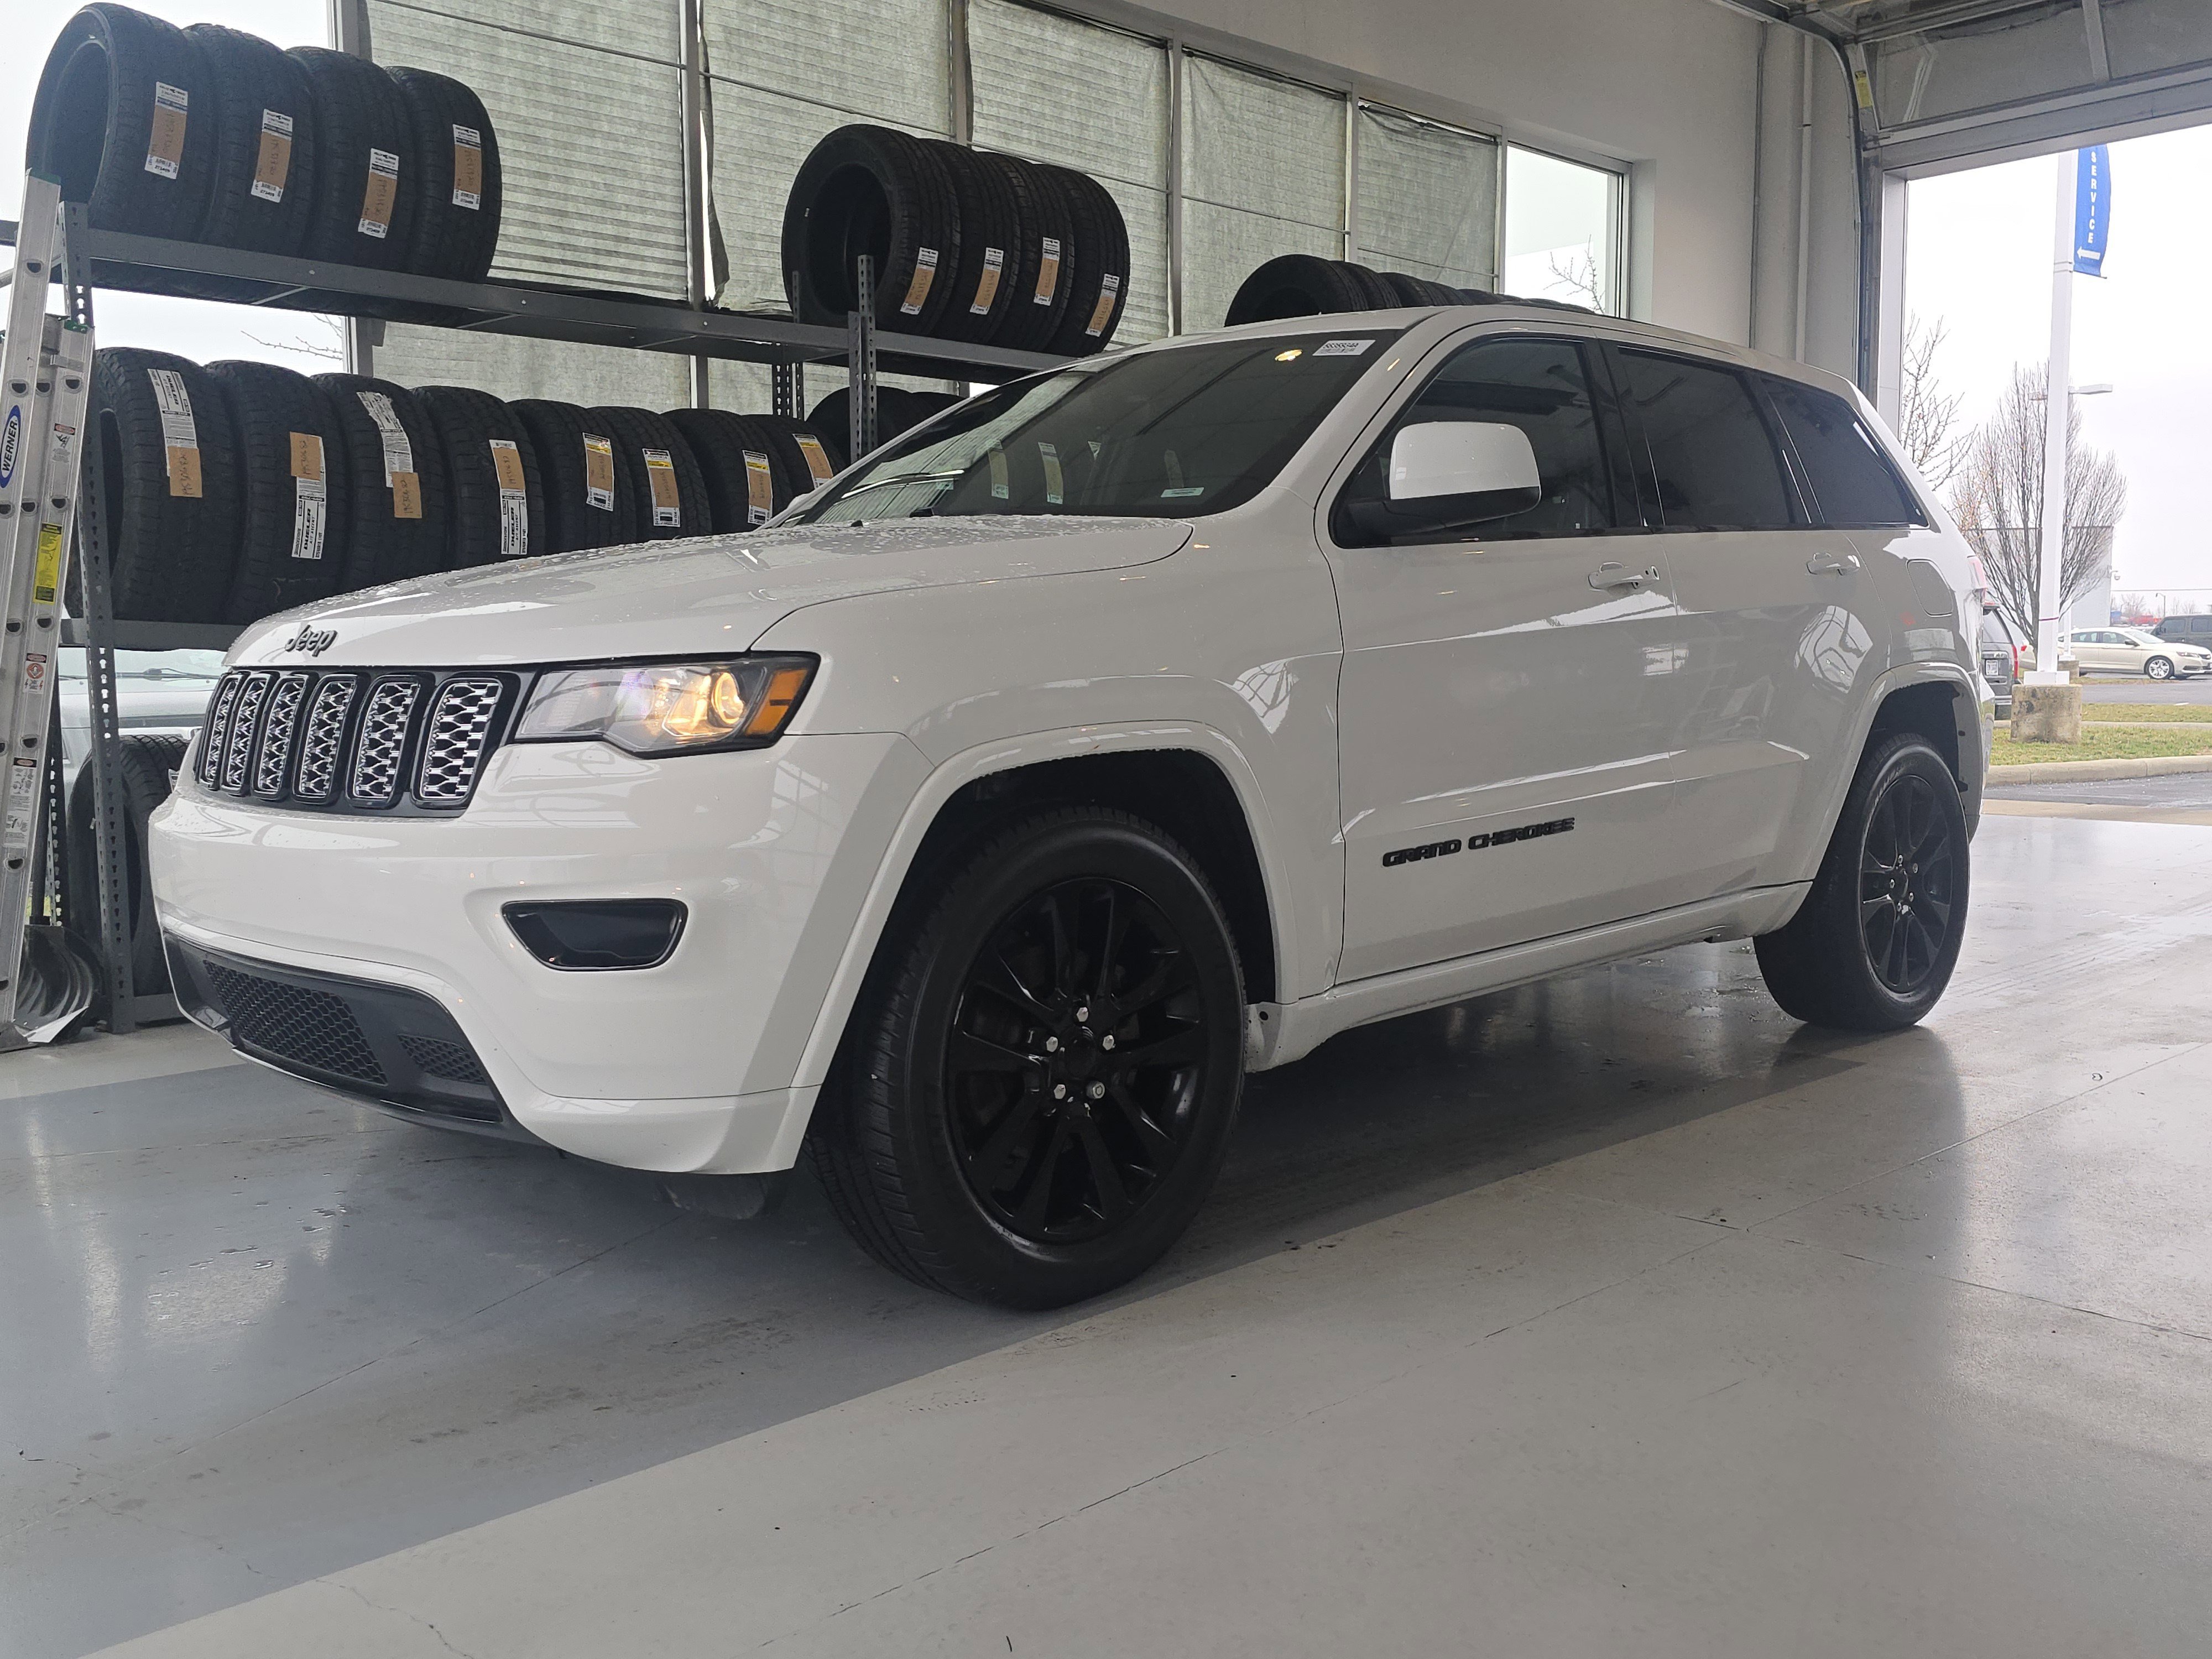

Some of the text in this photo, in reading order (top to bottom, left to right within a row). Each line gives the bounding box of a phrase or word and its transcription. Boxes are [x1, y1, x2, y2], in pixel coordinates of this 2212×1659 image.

[2088, 151, 2097, 244] SERVICE
[2, 420, 18, 471] WERNER
[284, 624, 338, 658] Jeep
[1383, 817, 1575, 867] GRAND CHEROKEE
